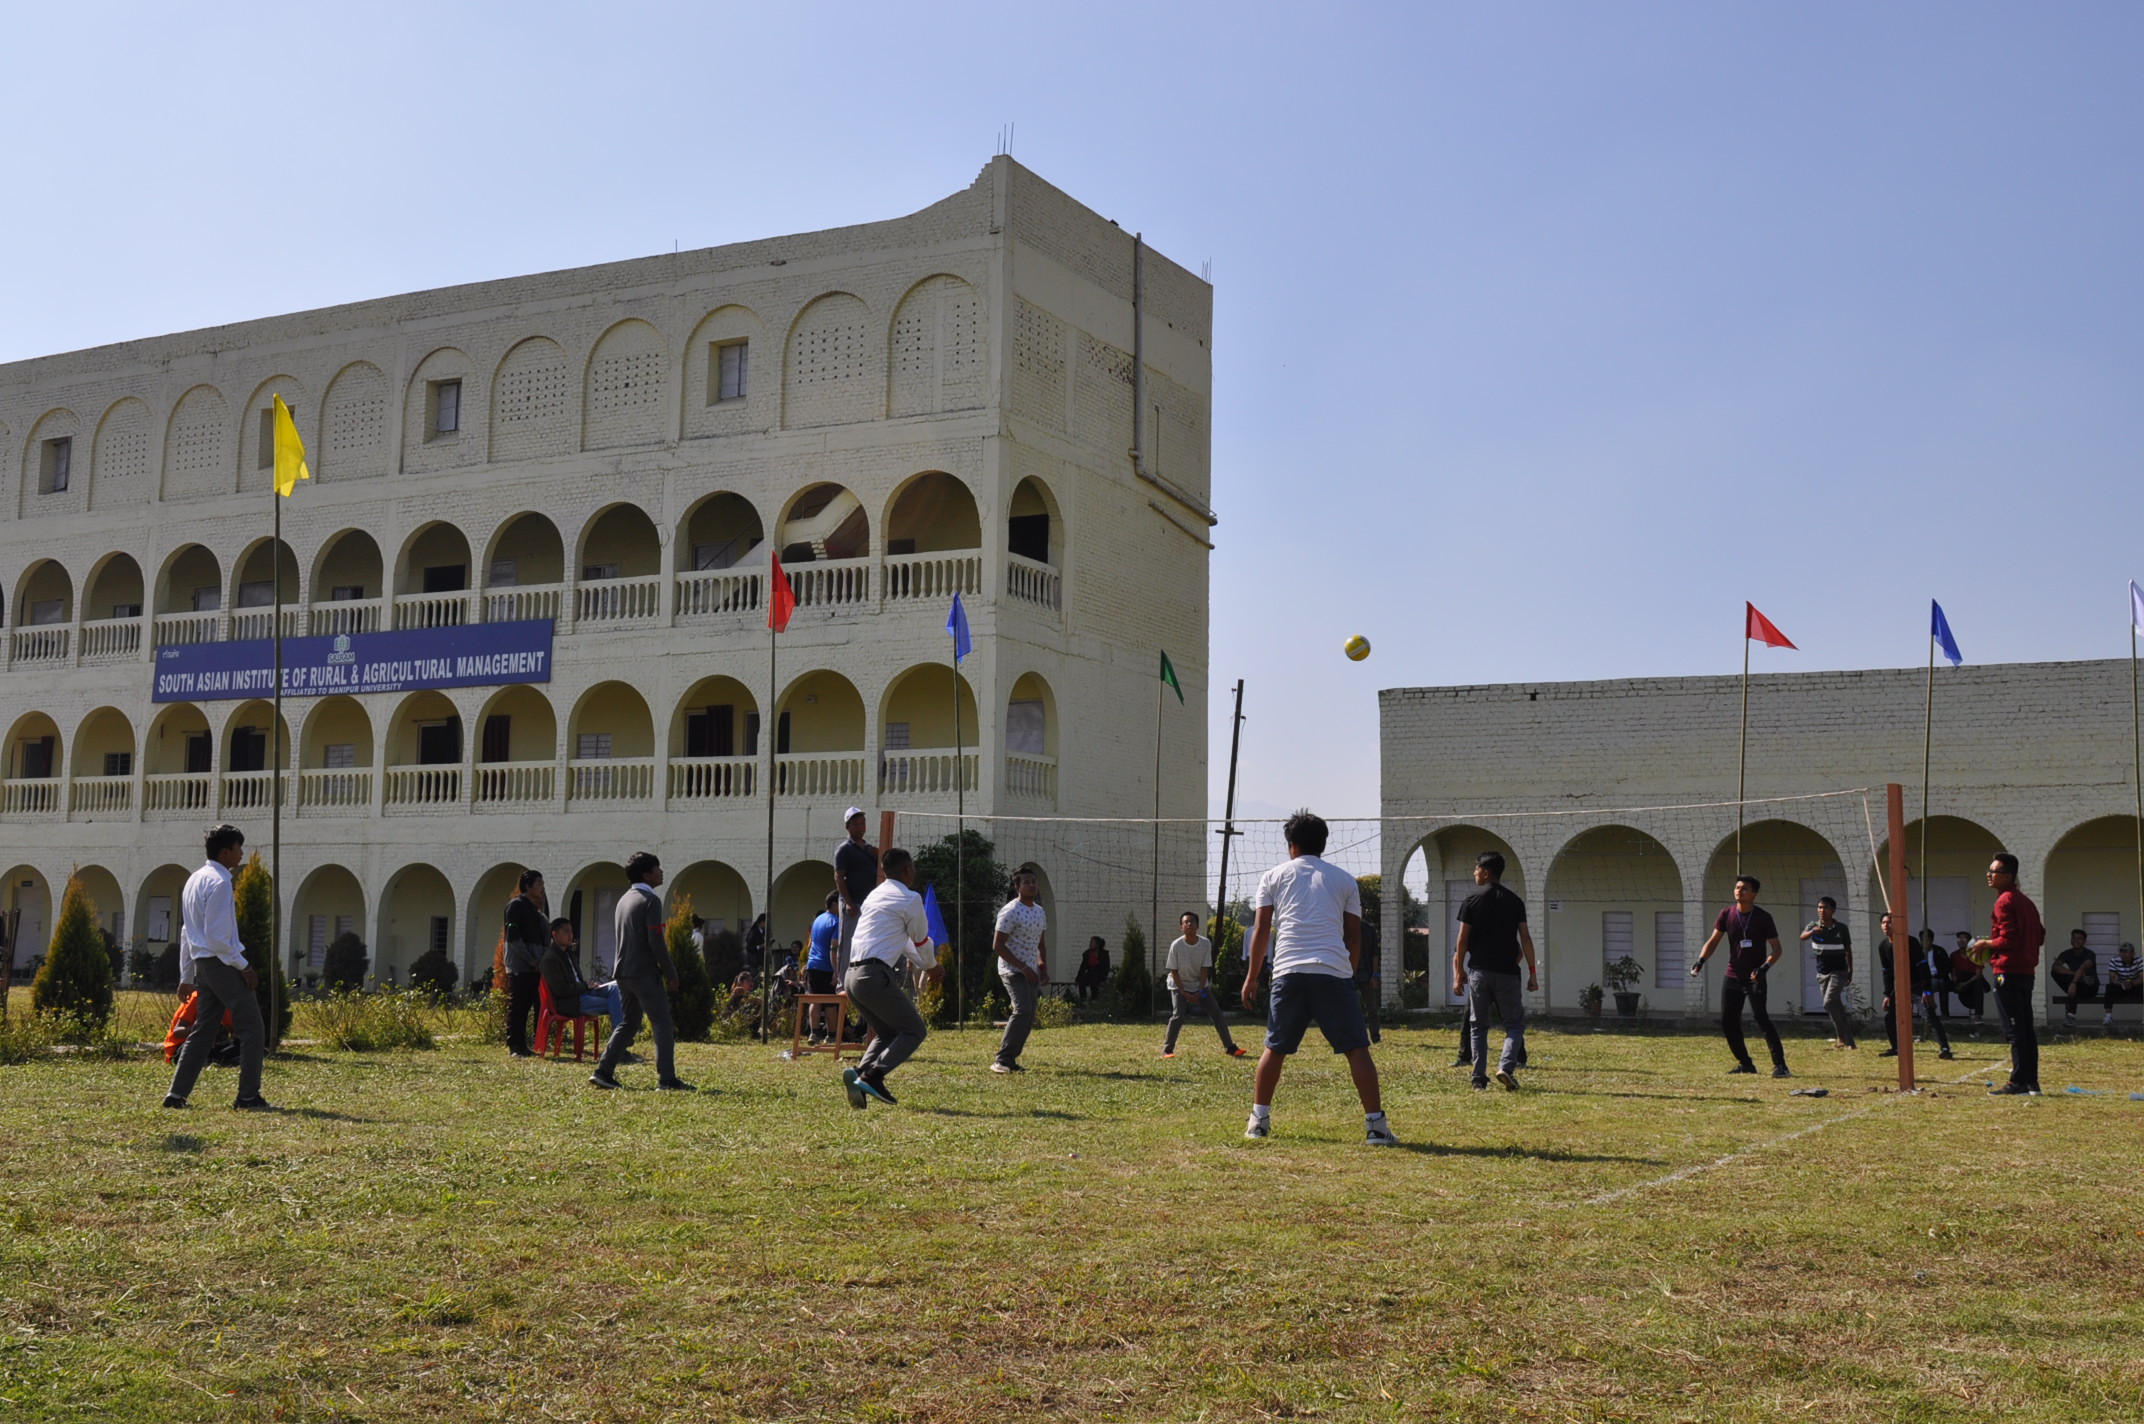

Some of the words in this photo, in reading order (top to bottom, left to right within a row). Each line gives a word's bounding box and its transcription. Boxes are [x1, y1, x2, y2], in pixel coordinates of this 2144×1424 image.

[158, 673, 194, 693] SOUTH
[197, 671, 230, 691] ASIAN
[232, 667, 290, 690] INSTITUE
[292, 667, 307, 687] OF
[310, 666, 347, 686] RURAL
[351, 664, 359, 684] &
[362, 658, 453, 684] AGRICULTURAL
[456, 651, 545, 677] MANAGEMENT
[328, 685, 360, 694] MANIPUR
[361, 683, 403, 693] UNIVERSITY
